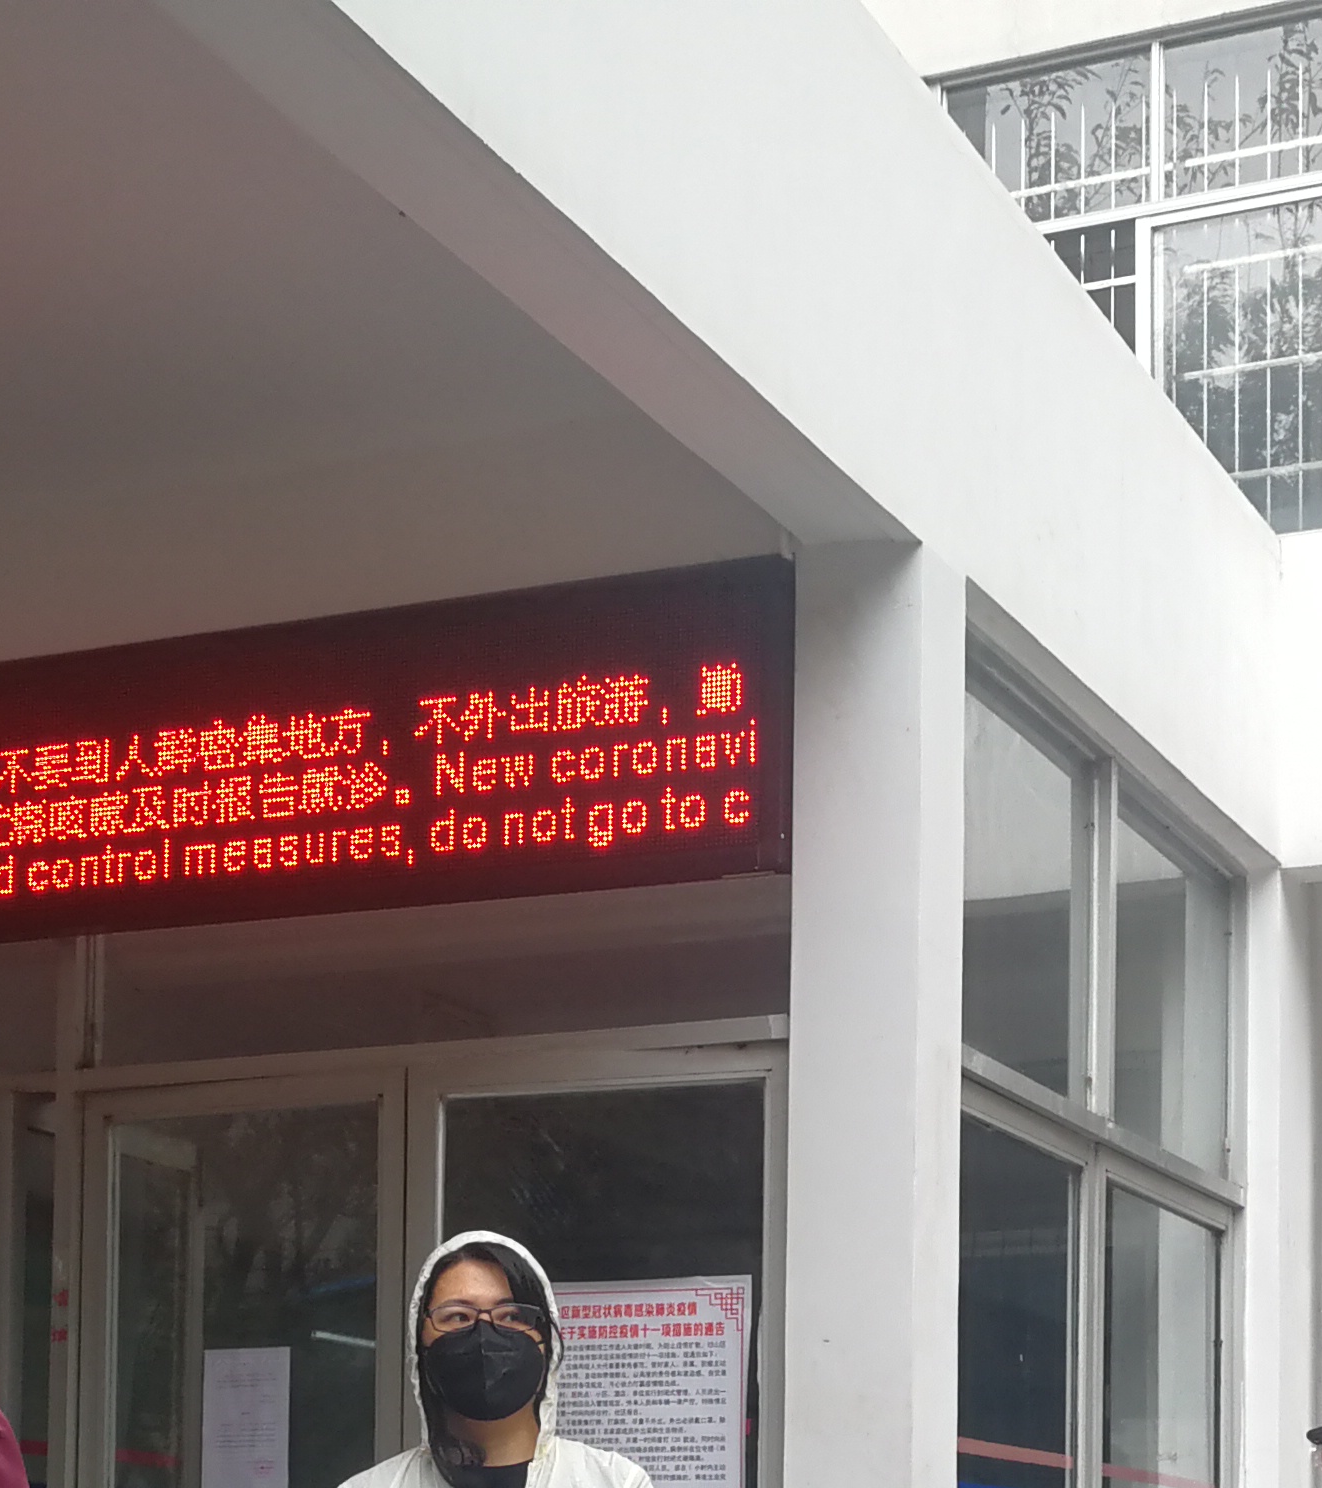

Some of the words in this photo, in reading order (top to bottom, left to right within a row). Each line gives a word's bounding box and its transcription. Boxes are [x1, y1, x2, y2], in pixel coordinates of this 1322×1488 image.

[436, 751, 534, 796] New
[550, 718, 756, 783] coronavi
[27, 836, 169, 892] control
[184, 824, 415, 876] measures,
[430, 808, 488, 852] do
[504, 796, 575, 846] not
[588, 801, 647, 847] go
[661, 786, 706, 831] to
